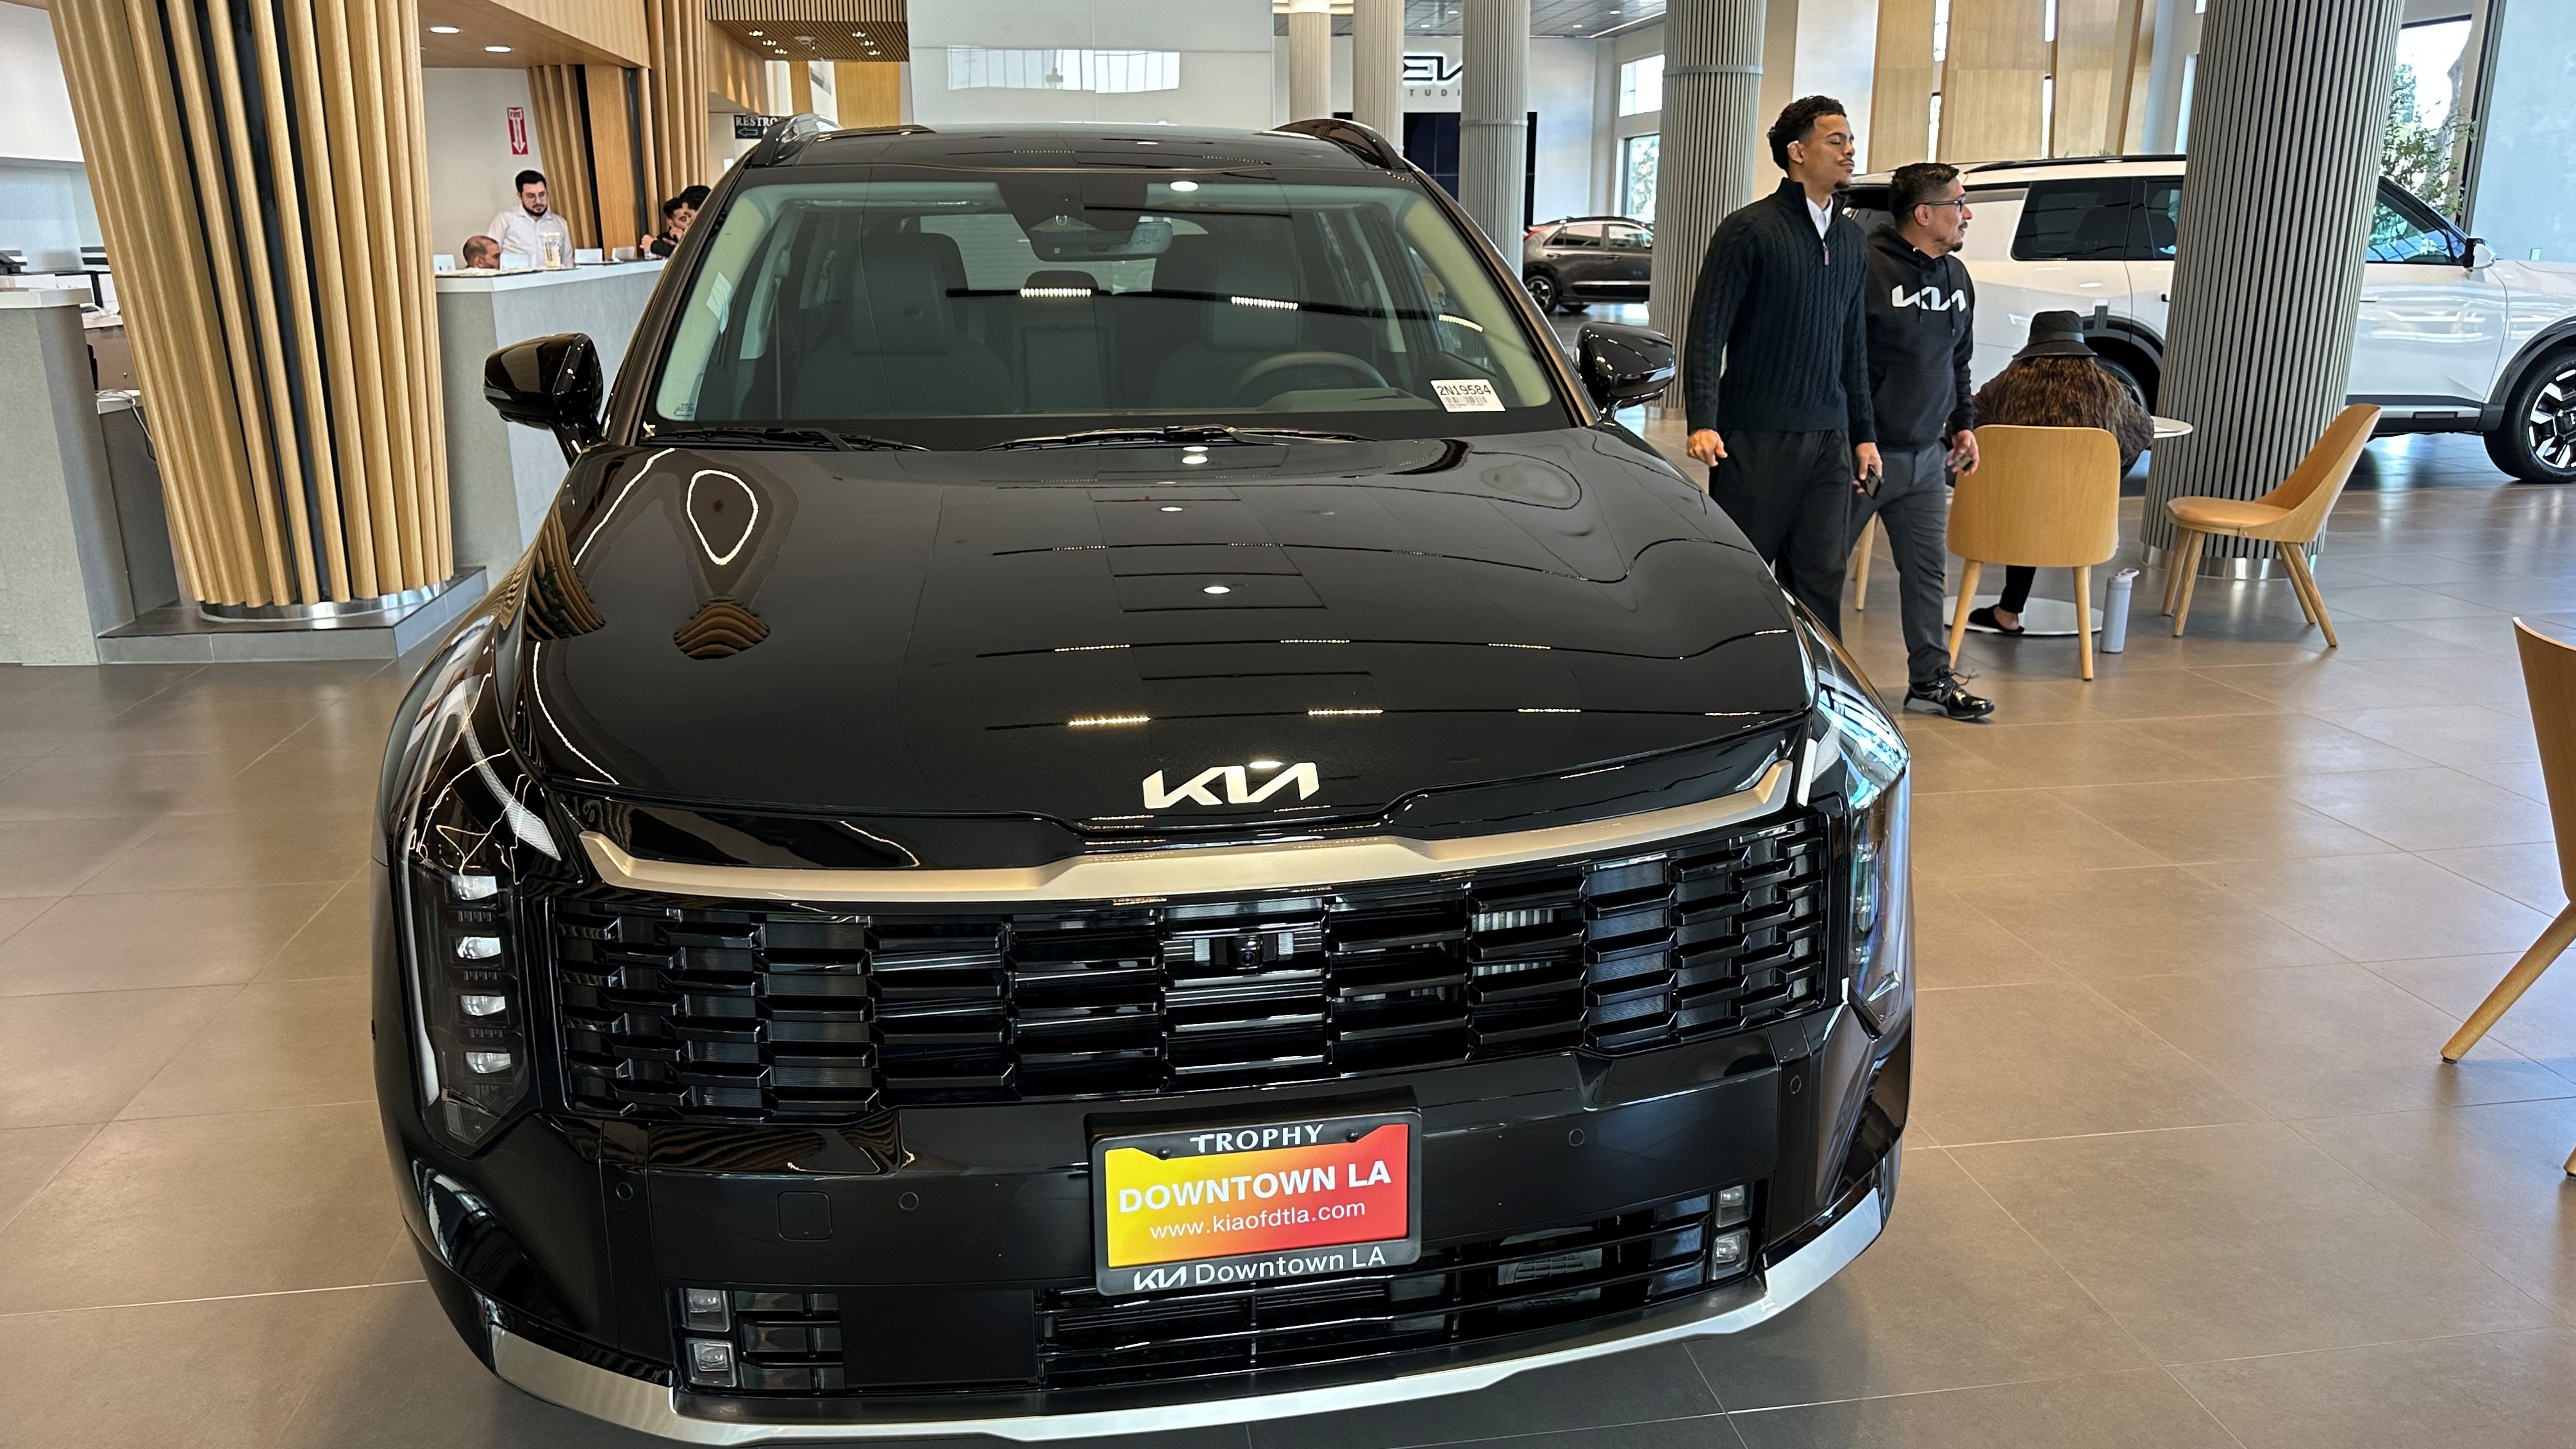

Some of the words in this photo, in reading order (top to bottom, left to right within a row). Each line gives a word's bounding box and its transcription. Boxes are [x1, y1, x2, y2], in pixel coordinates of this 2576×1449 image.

[735, 117, 778, 127] RESTRO
[1891, 285, 1966, 312] KIA
[1437, 385, 1491, 395] 2N19584
[1142, 762, 1319, 809] KIA
[1190, 1124, 1323, 1153] TROPHY
[1119, 1166, 1335, 1213] DOWNTOWN
[1348, 1160, 1391, 1188] LA
[1150, 1202, 1366, 1239] www.kiaofdtla.com
[1133, 1266, 1187, 1291] KIA
[1196, 1252, 1344, 1284] Downtown
[1351, 1246, 1385, 1268] LA
